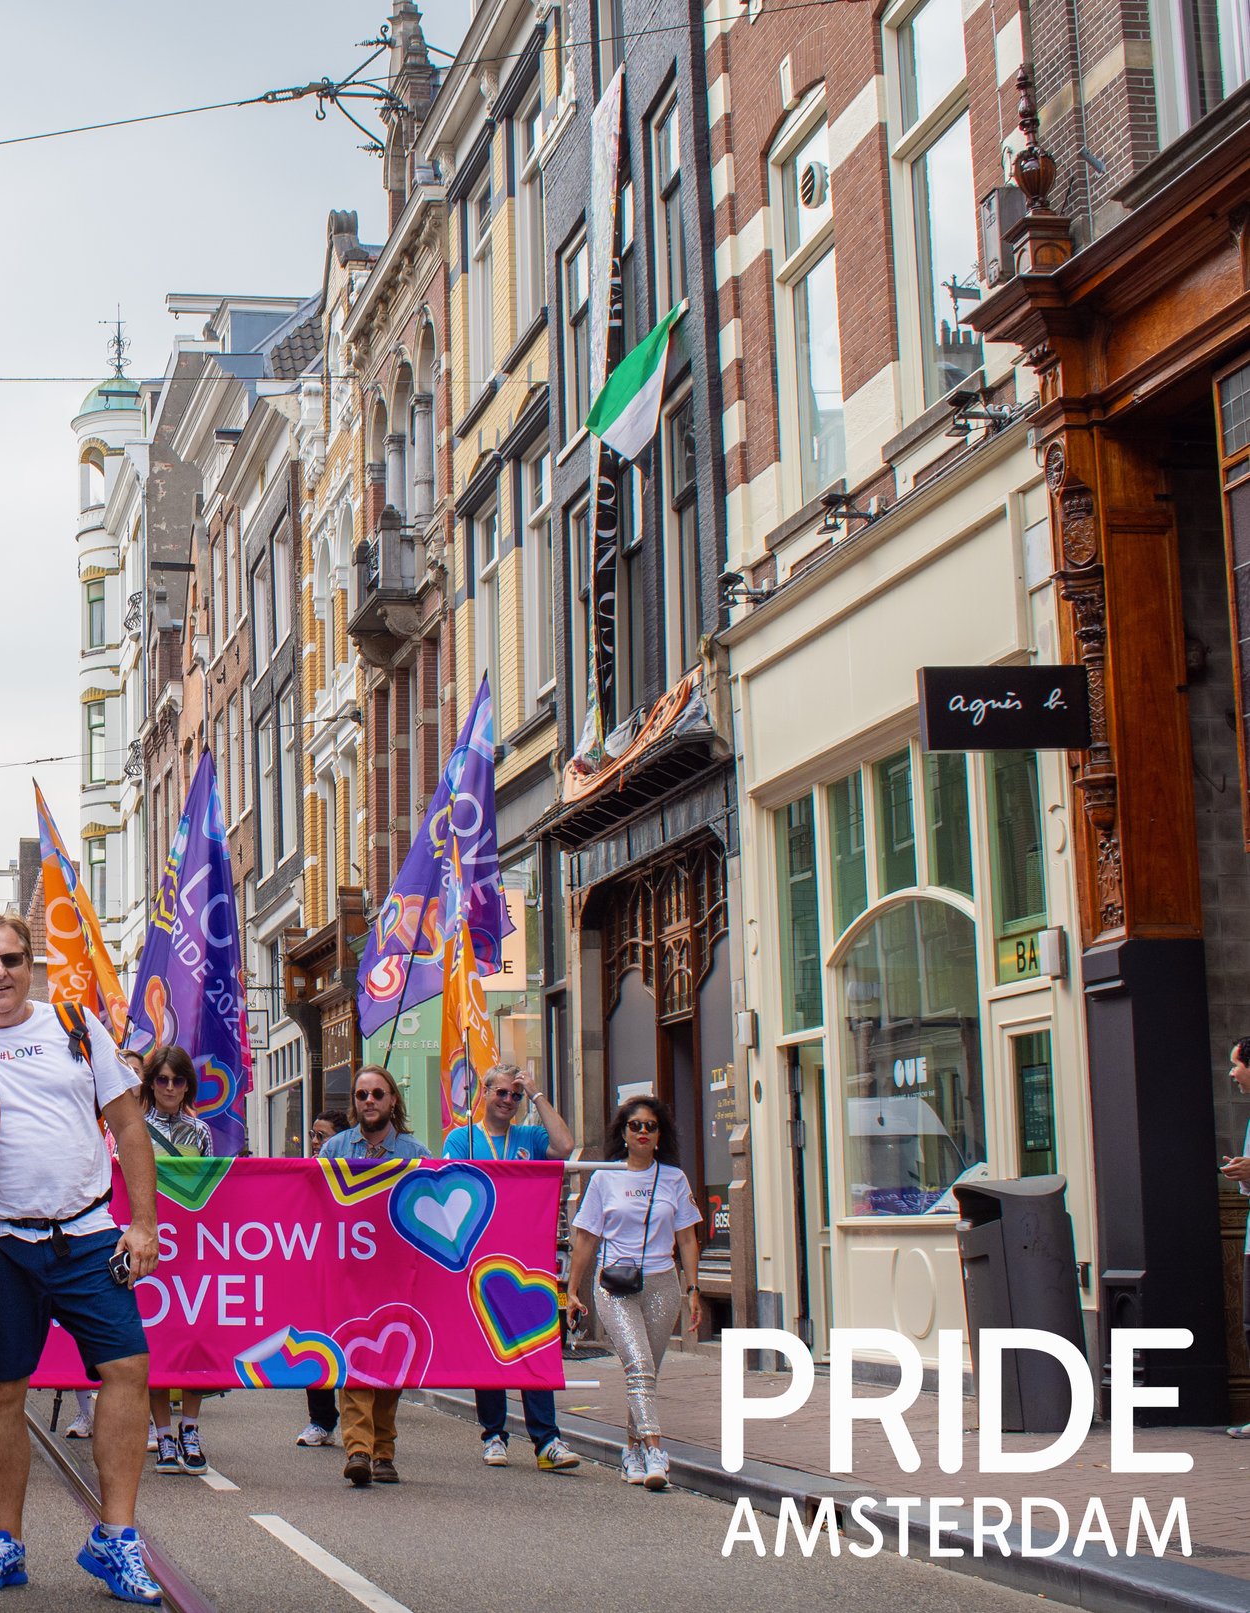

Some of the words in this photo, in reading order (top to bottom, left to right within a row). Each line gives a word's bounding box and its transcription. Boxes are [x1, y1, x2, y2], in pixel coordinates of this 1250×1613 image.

[948, 691, 1022, 726] agnès
[1043, 687, 1068, 710] b.
[449, 792, 506, 906] OVE
[1015, 937, 1039, 974] BA
[0, 1044, 44, 1061] #LOVE
[625, 1189, 653, 1198] #LOVE
[197, 1222, 322, 1261] NOW
[338, 1221, 377, 1261] IS
[133, 1275, 265, 1328] OVE!
